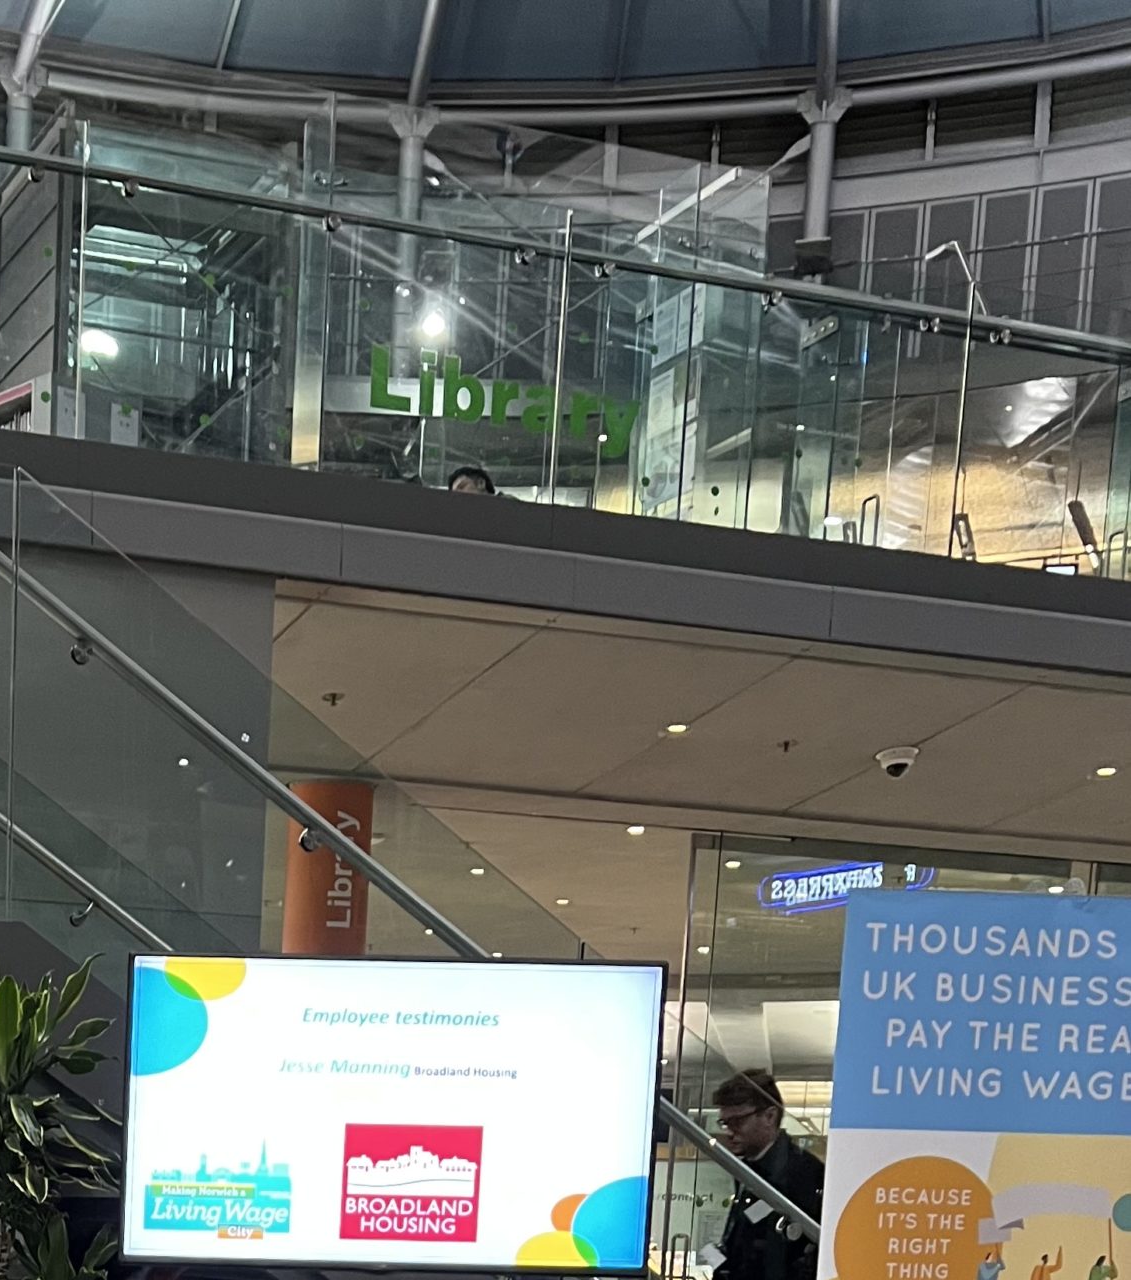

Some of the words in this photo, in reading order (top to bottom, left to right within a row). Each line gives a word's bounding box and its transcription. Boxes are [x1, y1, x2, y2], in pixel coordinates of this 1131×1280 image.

[369, 343, 640, 459] Library
[326, 810, 360, 928] Libry
[865, 922, 1118, 959] THOUSANDS
[862, 970, 917, 1001] UK
[302, 1007, 390, 1027] Employee
[395, 1010, 501, 1027] testimonies
[885, 1018, 953, 1049] PAY
[968, 1020, 1042, 1053] THE
[279, 1059, 325, 1074] Jesse
[330, 1059, 412, 1079] Manning
[414, 1066, 471, 1077] Broadland
[473, 1067, 518, 1080] Housing
[871, 1065, 1003, 1098] LIVING
[162, 1185, 197, 1197] Making
[198, 1185, 239, 1197] Norwich
[875, 1187, 973, 1206] BECAUSE
[151, 1197, 222, 1227] Living
[223, 1199, 289, 1227] Wage
[344, 1197, 474, 1216] BROADLAND
[359, 1216, 457, 1234] HOUSING
[878, 1212, 918, 1230] IT'S
[927, 1213, 966, 1231] THE
[227, 1225, 254, 1240] City
[887, 1237, 951, 1255] RIGHT
[886, 1262, 949, 1280] THING
